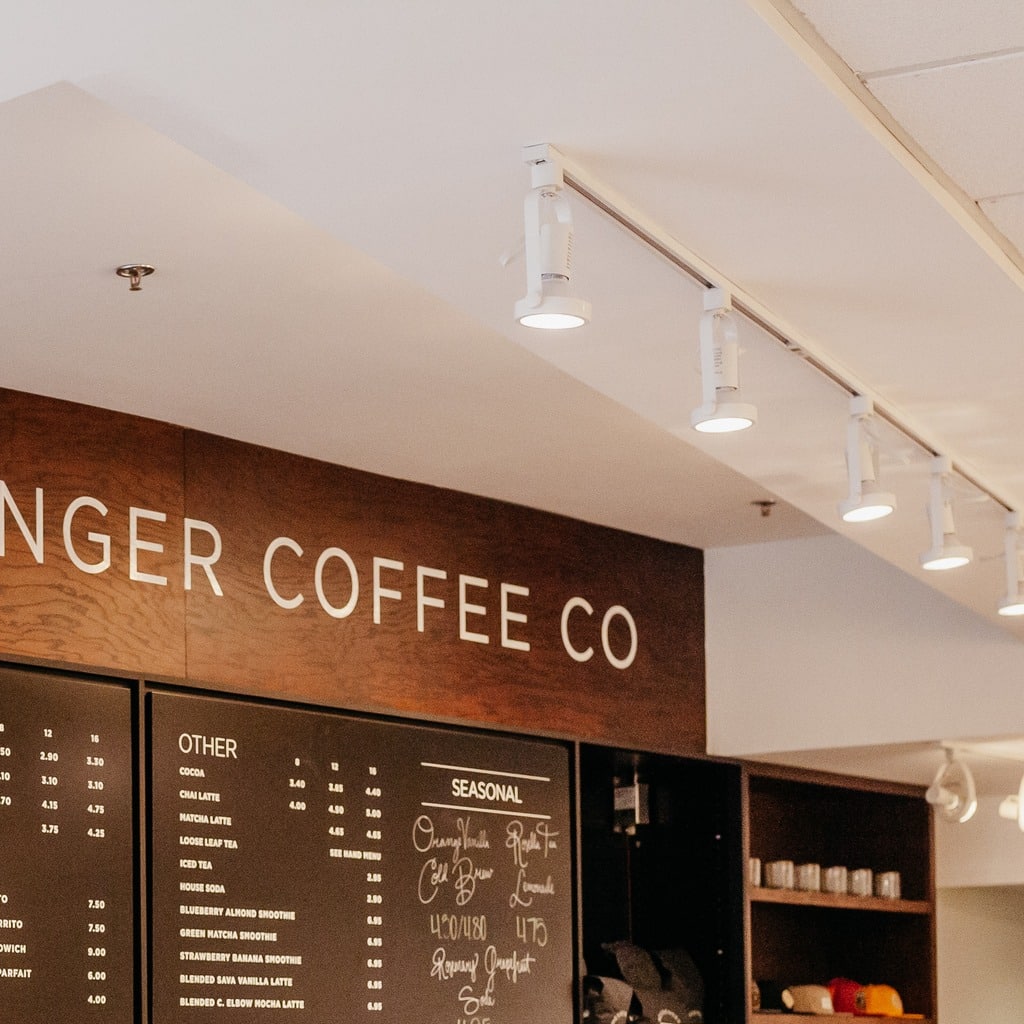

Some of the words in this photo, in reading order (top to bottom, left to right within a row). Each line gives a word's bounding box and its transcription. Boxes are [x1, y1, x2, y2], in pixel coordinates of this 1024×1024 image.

[262, 535, 532, 652] COFFEE
[560, 596, 638, 671] CO
[0, 723, 5, 732] 8
[43, 728, 53, 738] 12
[90, 734, 99, 743] 16
[178, 733, 238, 759] OTHER
[40, 751, 59, 762] 2.90
[86, 756, 105, 767] 3.30
[179, 767, 205, 778] COCOA
[41, 776, 58, 786] 3.10
[87, 780, 104, 791] 3.10
[179, 790, 197, 801] CHAI
[198, 791, 220, 802] LATTE
[452, 778, 522, 803] SEASONAL
[42, 800, 58, 810] 4.15
[87, 804, 105, 815] 4.75
[179, 813, 209, 824] MATCHA
[210, 815, 232, 826] LATTE
[41, 824, 59, 834] 3.75
[87, 828, 105, 838] 4.25
[179, 836, 203, 847] LOOSE
[205, 838, 223, 848] LEAF
[224, 839, 238, 849] TEA
[330, 848, 342, 859] SEE
[343, 850, 362, 860] HAND
[362, 851, 381, 861] MENU
[179, 859, 197, 869] ICED
[198, 860, 213, 870] TEA
[418, 857, 448, 904] Cold
[452, 857, 494, 906] Brew
[179, 882, 205, 893] HOUSE
[205, 884, 225, 894] SODA
[88, 900, 106, 909] 7.50
[179, 905, 224, 916] BLUEBERRY
[225, 907, 257, 918] ALMOND
[258, 910, 296, 920] SMOOTHIE
[88, 924, 106, 933] 7.50
[179, 928, 206, 938] GREEN
[207, 930, 238, 940] MATCHA
[239, 931, 277, 941] SMOOTHIE
[87, 948, 107, 957] 9.00
[179, 952, 231, 962] STRAWBERRY
[232, 953, 264, 963] BANANA
[265, 955, 302, 965] SMOOTHIE
[87, 972, 107, 981] 6.00
[179, 974, 215, 984] BLENDED
[216, 976, 236, 985] SAVA
[238, 976, 269, 986] VANILLA
[270, 977, 293, 987] LATTE
[87, 995, 107, 1004] 4.00
[179, 997, 215, 1008] BLENDED
[226, 999, 253, 1008] ELBOW
[254, 999, 282, 1009] MOCHA
[282, 1000, 305, 1009] LATTE
